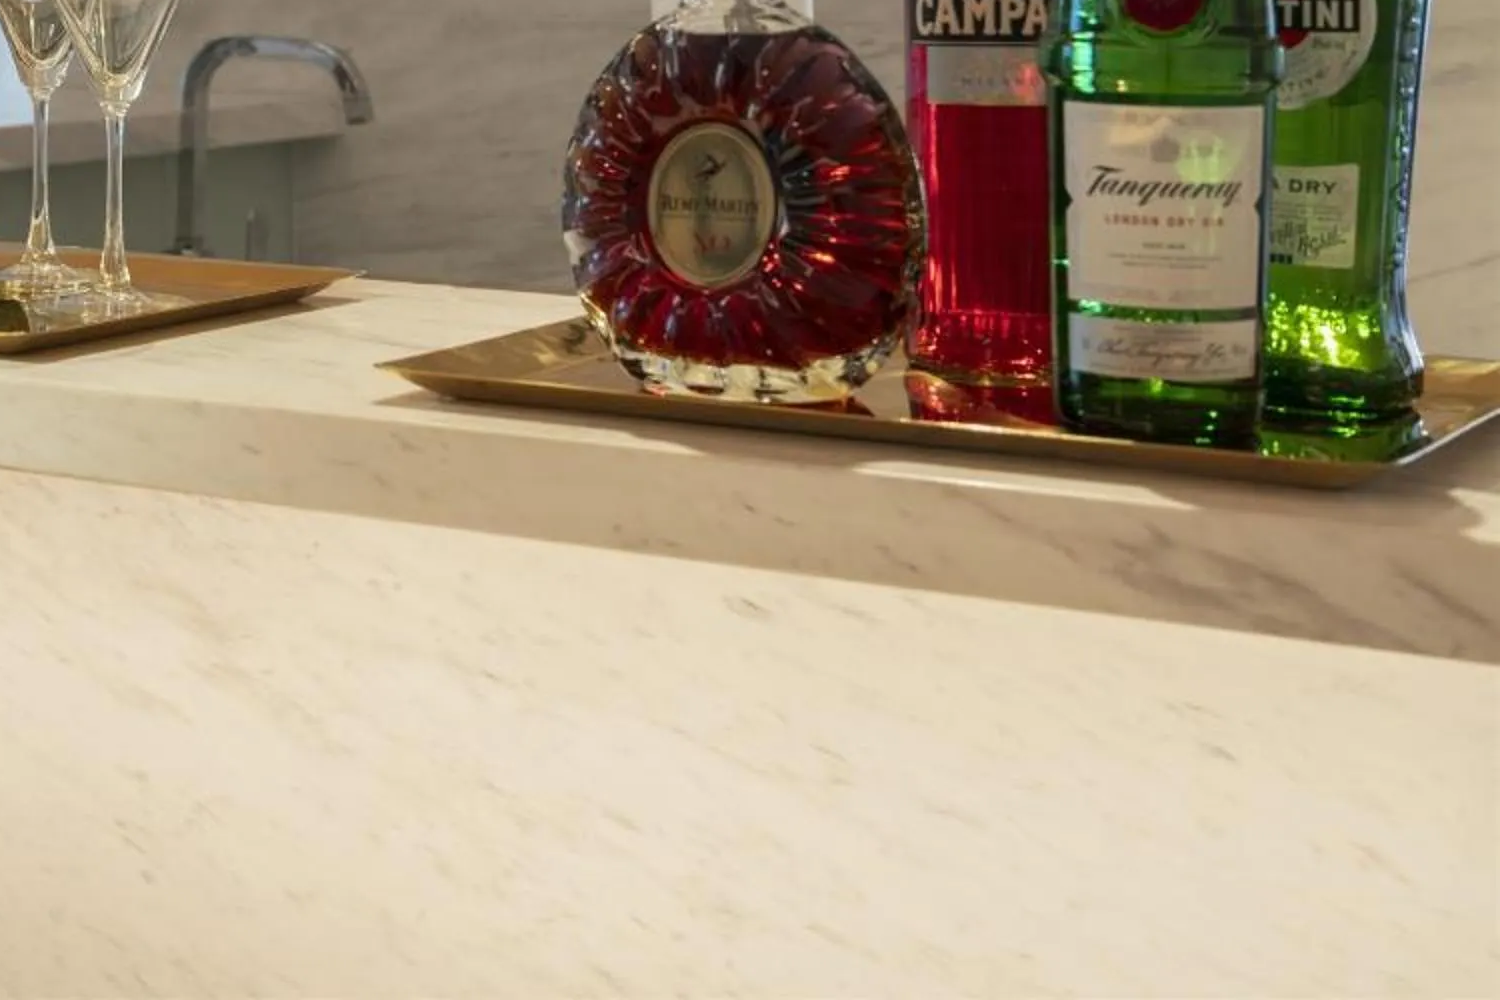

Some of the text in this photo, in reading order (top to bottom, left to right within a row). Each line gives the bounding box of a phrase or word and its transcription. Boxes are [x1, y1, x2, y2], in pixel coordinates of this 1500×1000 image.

[1277, 0, 1354, 29] TINI
[1086, 165, 1242, 207] Tanqueray
[1288, 179, 1338, 195] DRY
[1103, 213, 1160, 227] LONDON
[1166, 215, 1196, 228] DRY
